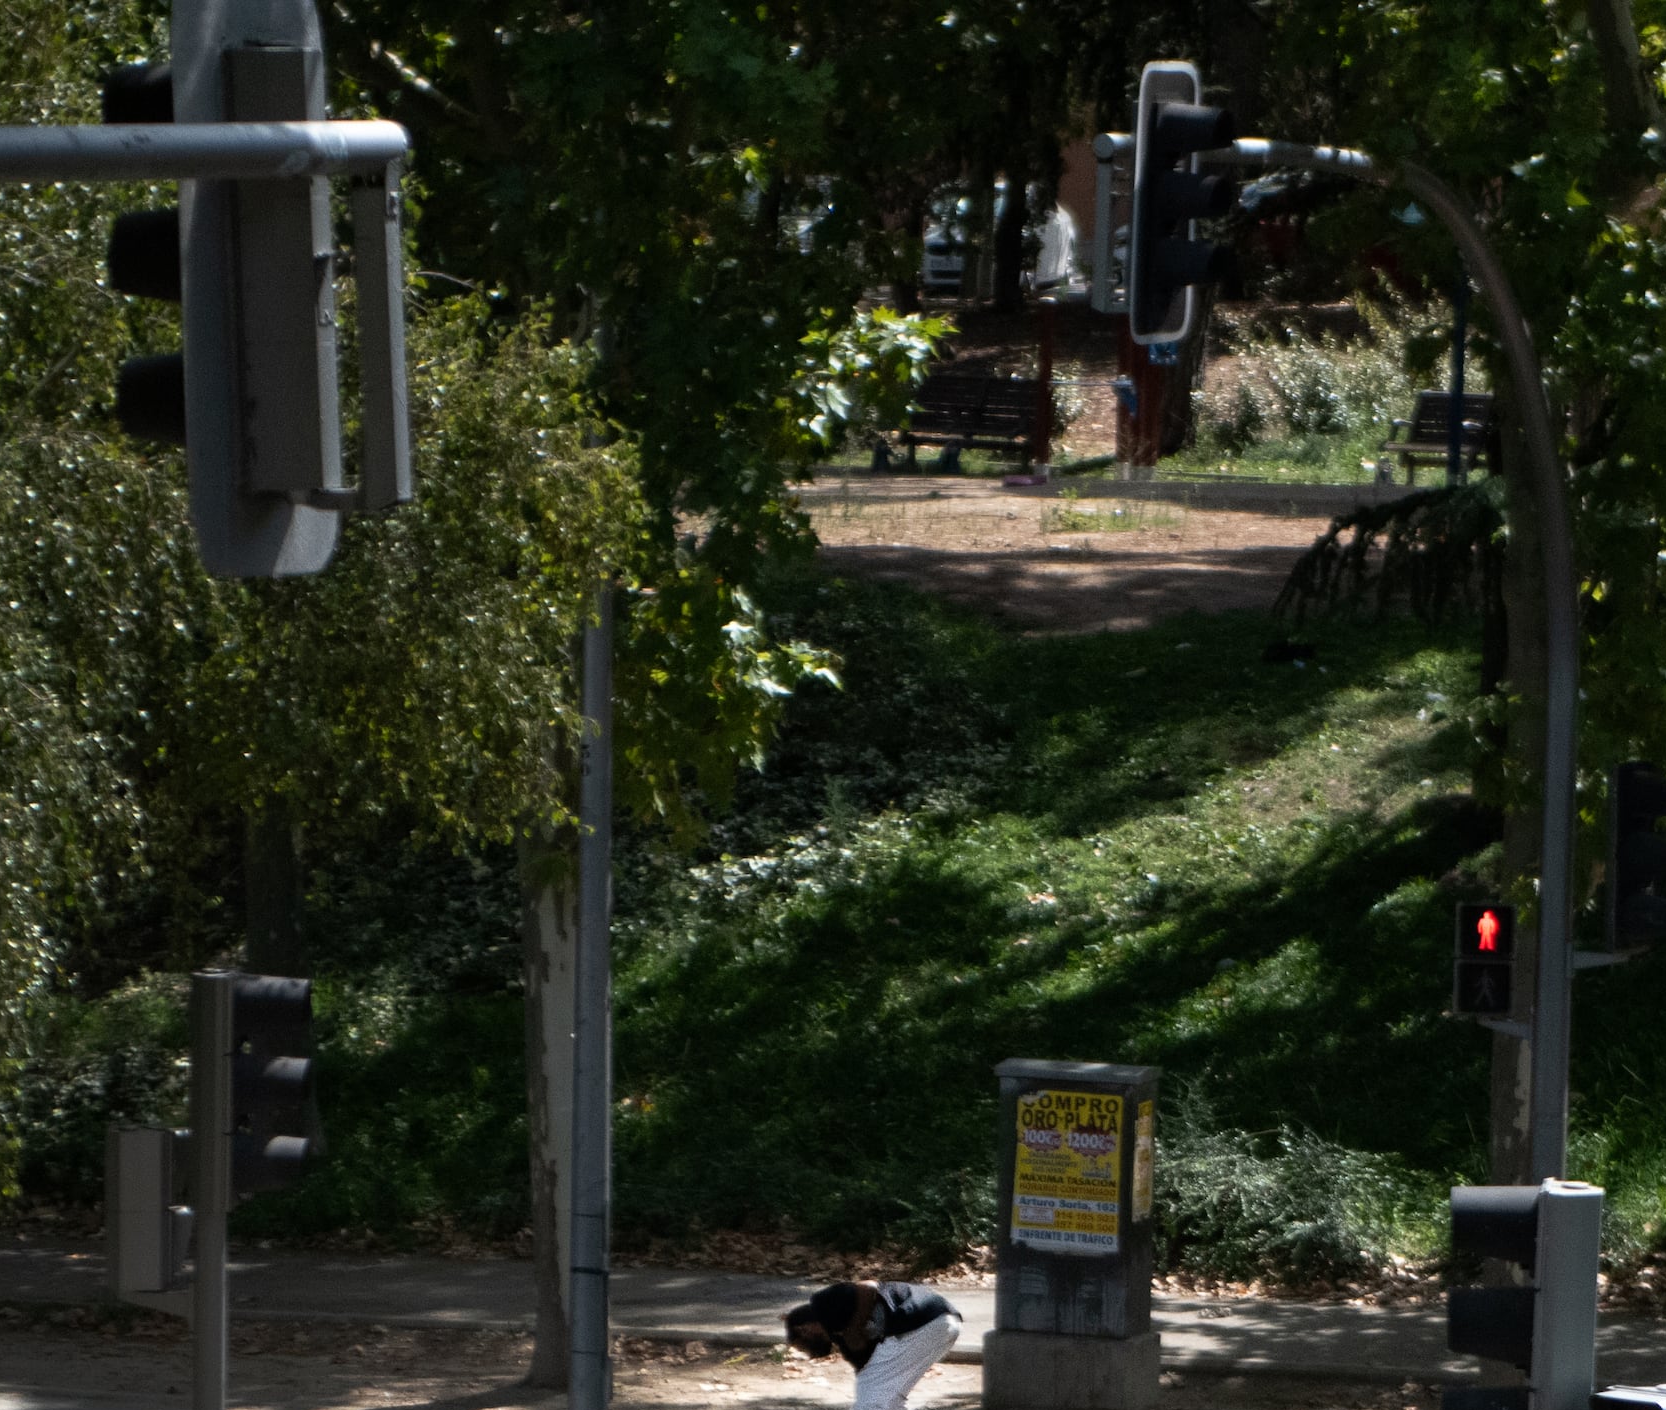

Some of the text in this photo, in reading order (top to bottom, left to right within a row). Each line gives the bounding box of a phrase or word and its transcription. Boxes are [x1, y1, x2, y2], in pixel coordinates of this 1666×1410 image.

[1019, 1196, 1055, 1207] Arturo
[1019, 1228, 1062, 1240] ENFRENTE
[1064, 1231, 1076, 1242] DE
